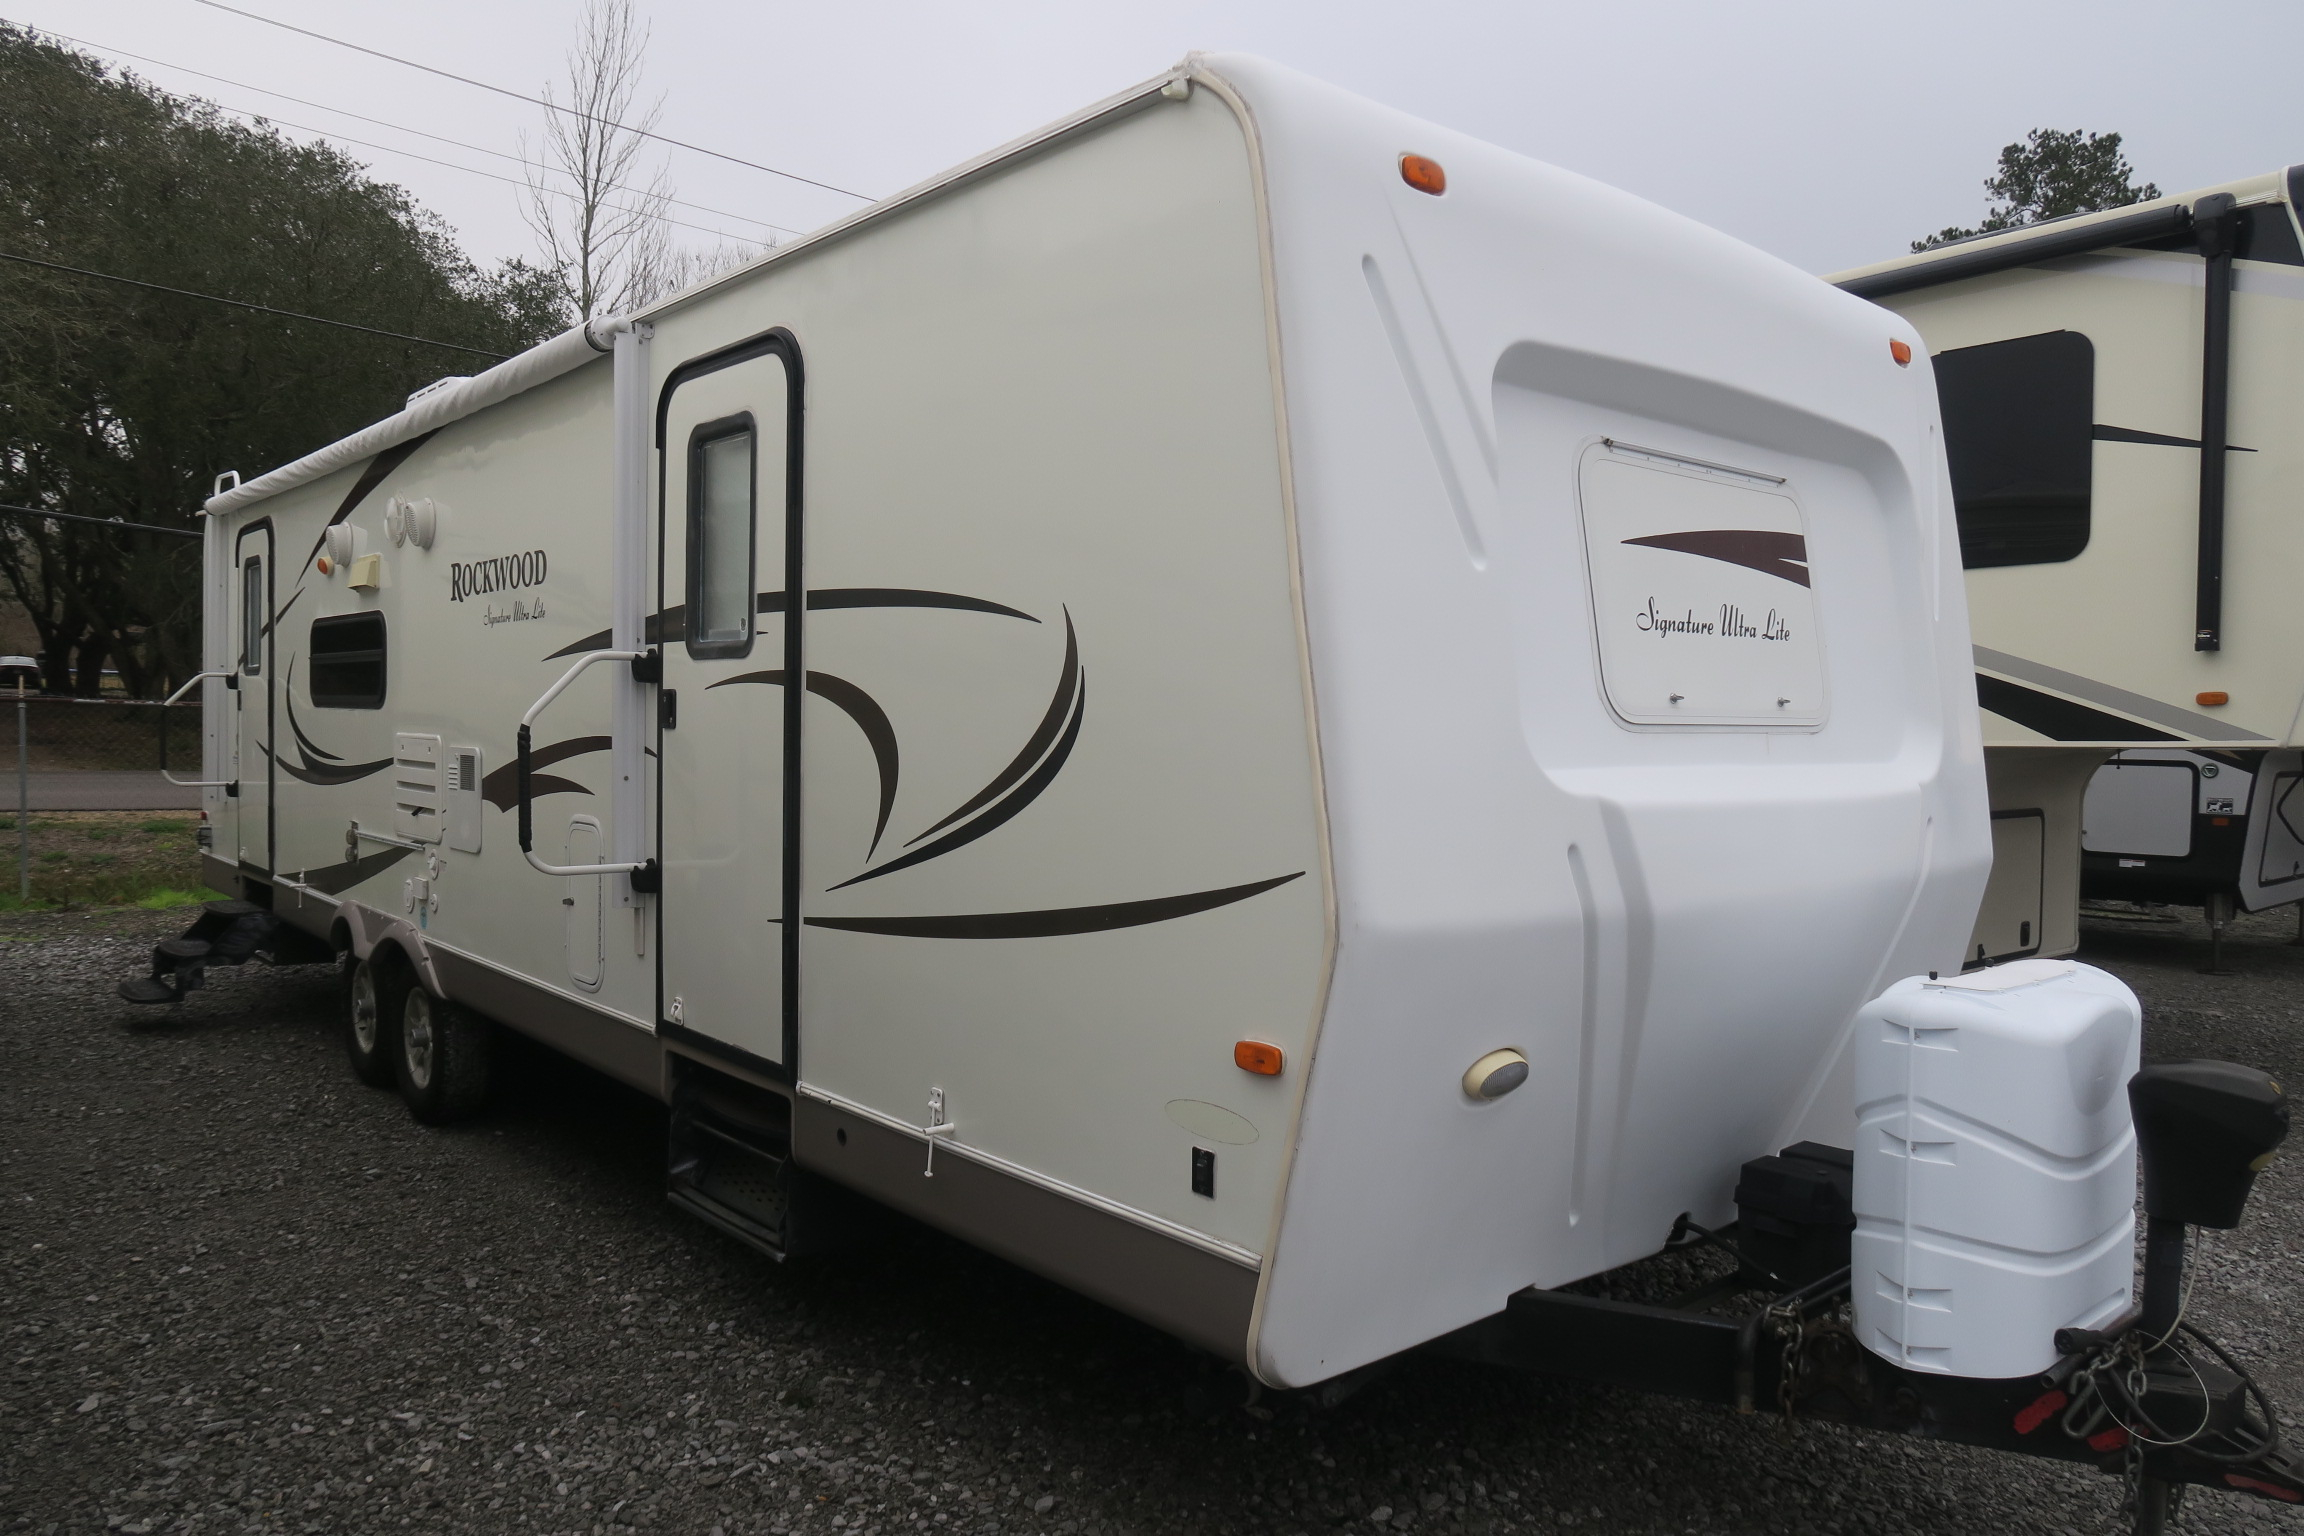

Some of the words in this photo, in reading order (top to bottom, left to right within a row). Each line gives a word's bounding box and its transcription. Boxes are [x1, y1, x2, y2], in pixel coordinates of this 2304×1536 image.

[450, 550, 547, 602] ROCKWOOD
[483, 604, 511, 628] Signature
[513, 600, 529, 622] Ultra
[531, 597, 546, 620] Lite
[1636, 596, 1713, 638] Signature
[1719, 603, 1757, 638] Ultra
[1761, 608, 1790, 641] Lite
